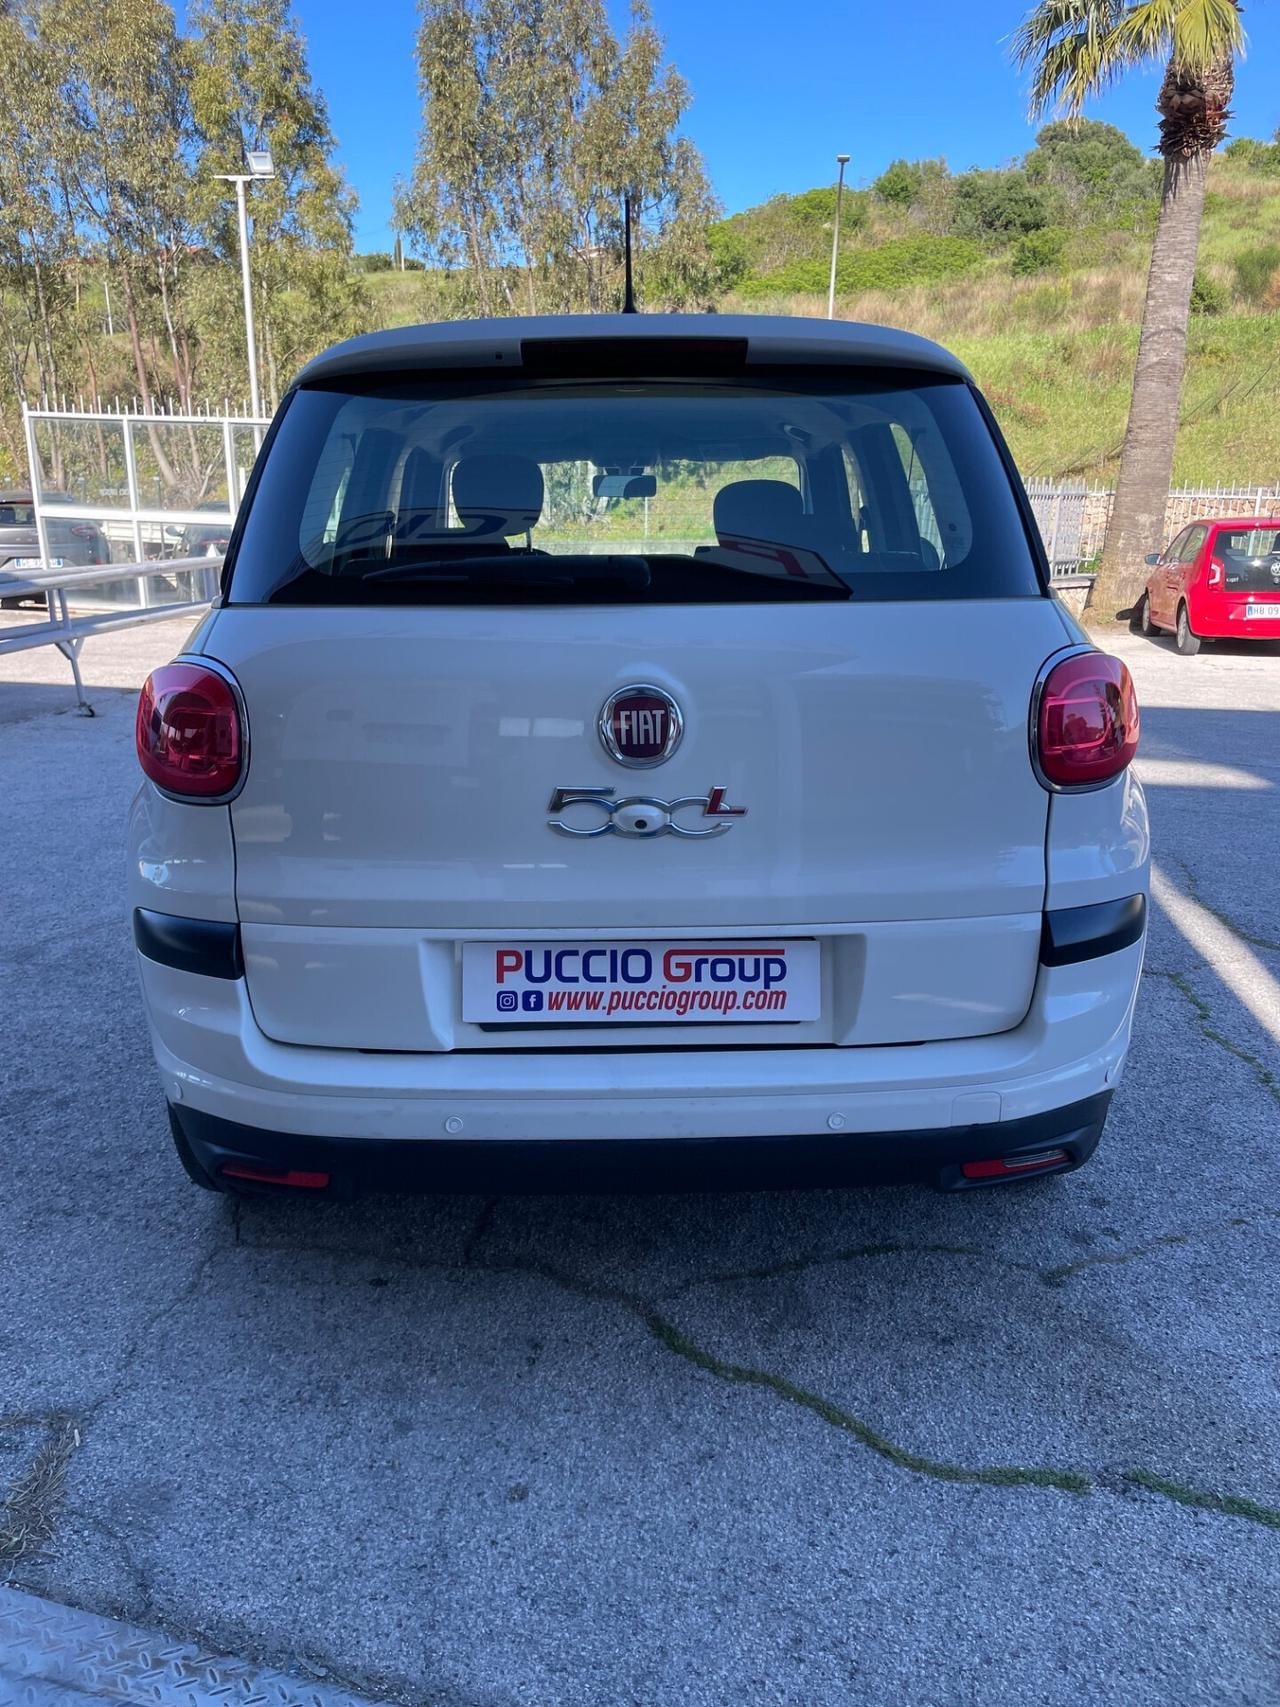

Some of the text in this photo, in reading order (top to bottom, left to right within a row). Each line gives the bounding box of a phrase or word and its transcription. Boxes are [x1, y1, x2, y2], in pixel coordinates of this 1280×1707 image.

[620, 710, 665, 745] FIAT
[496, 948, 787, 989] PUCCIO Group
[548, 985, 787, 1016] www.pucciogroup.com
